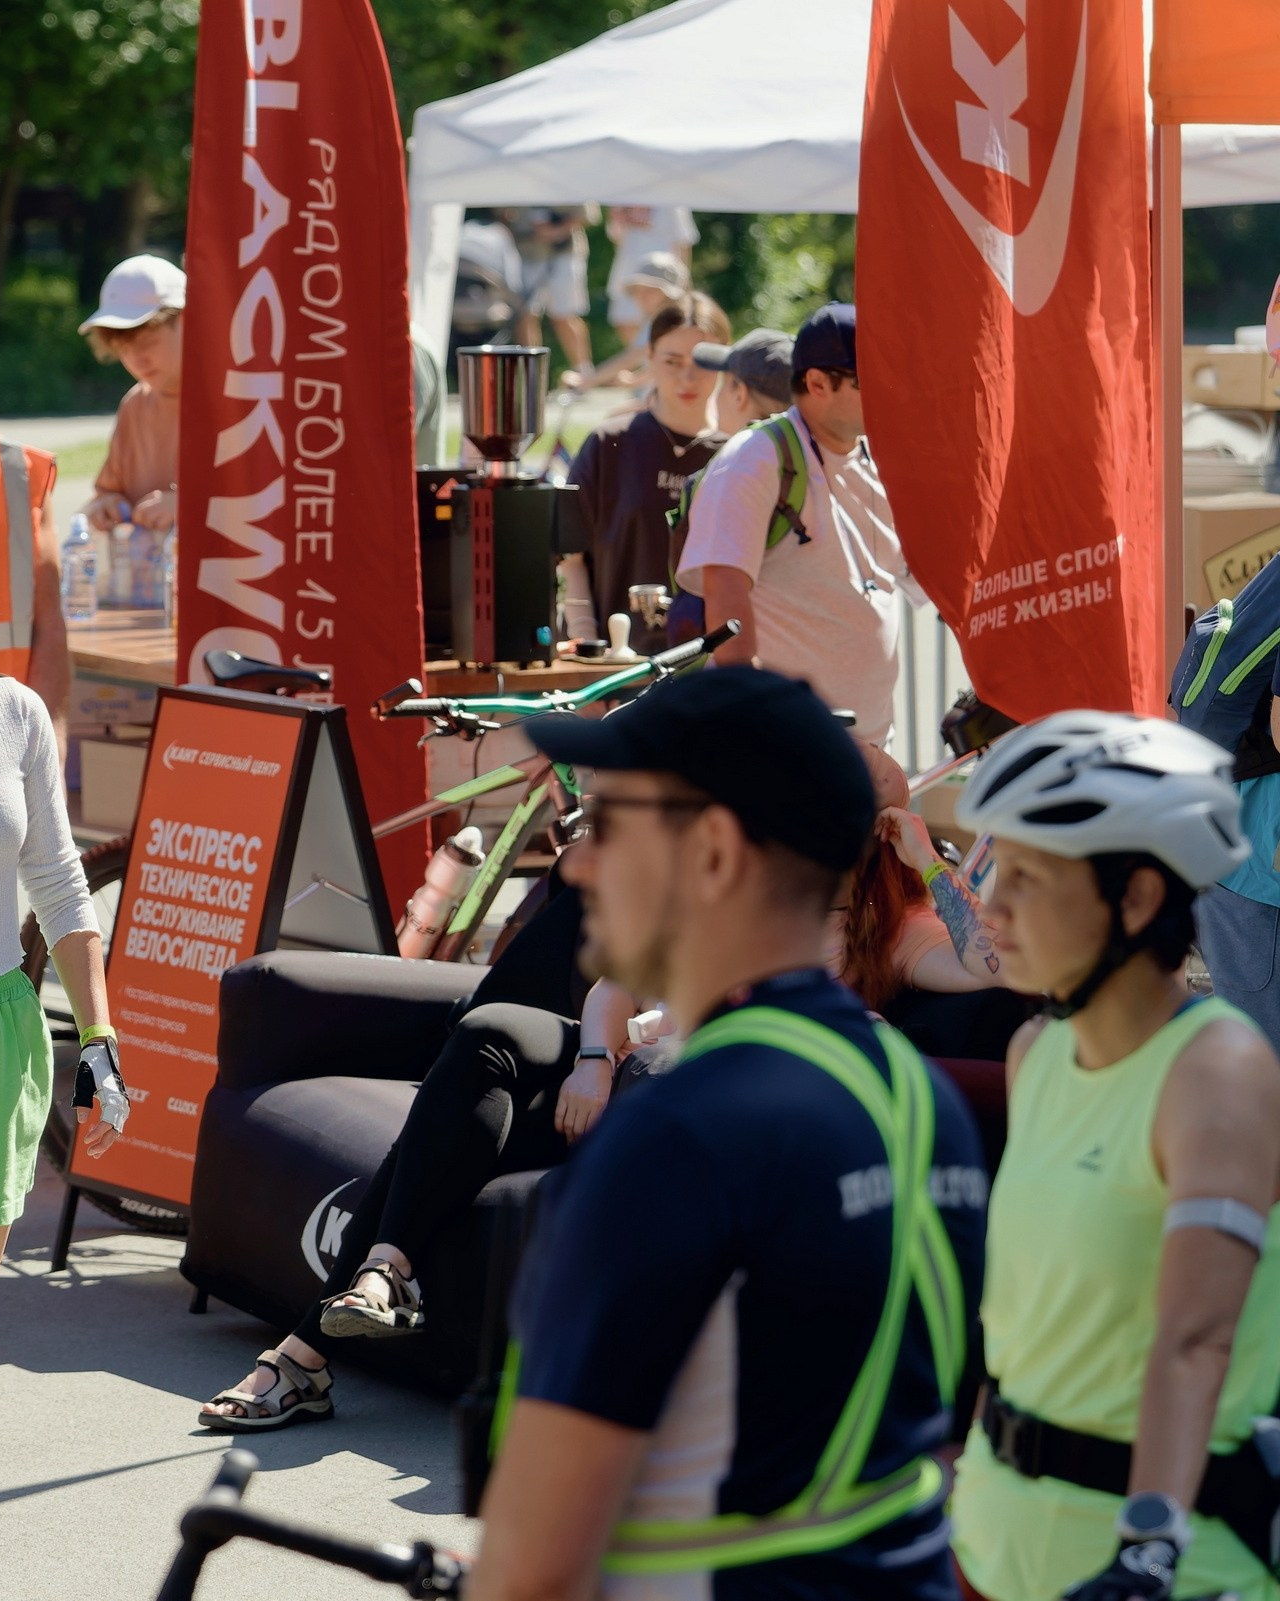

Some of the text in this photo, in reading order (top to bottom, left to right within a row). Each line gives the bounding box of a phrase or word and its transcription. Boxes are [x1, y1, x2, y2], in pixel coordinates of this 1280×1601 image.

[293, 137, 348, 362] РЯДОМ
[293, 376, 346, 564] БОЛЕЕ
[295, 578, 337, 640] 15
[968, 576, 1113, 639] ЯРЧЕ ЖИЗНЬ!
[972, 558, 1048, 605] БОЛЬШЕ
[198, 750, 254, 774] СЕРВИСНЫЙ
[249, 758, 282, 778] ЦЕНТР
[145, 817, 263, 875] ЭКСПРЕСС
[139, 862, 254, 913] ТЕХНИЧЕСКОЕ
[131, 897, 246, 945] ОБСЛУЖИВАНИЕ
[124, 926, 239, 981] ВЕЛОСИПЕДА
